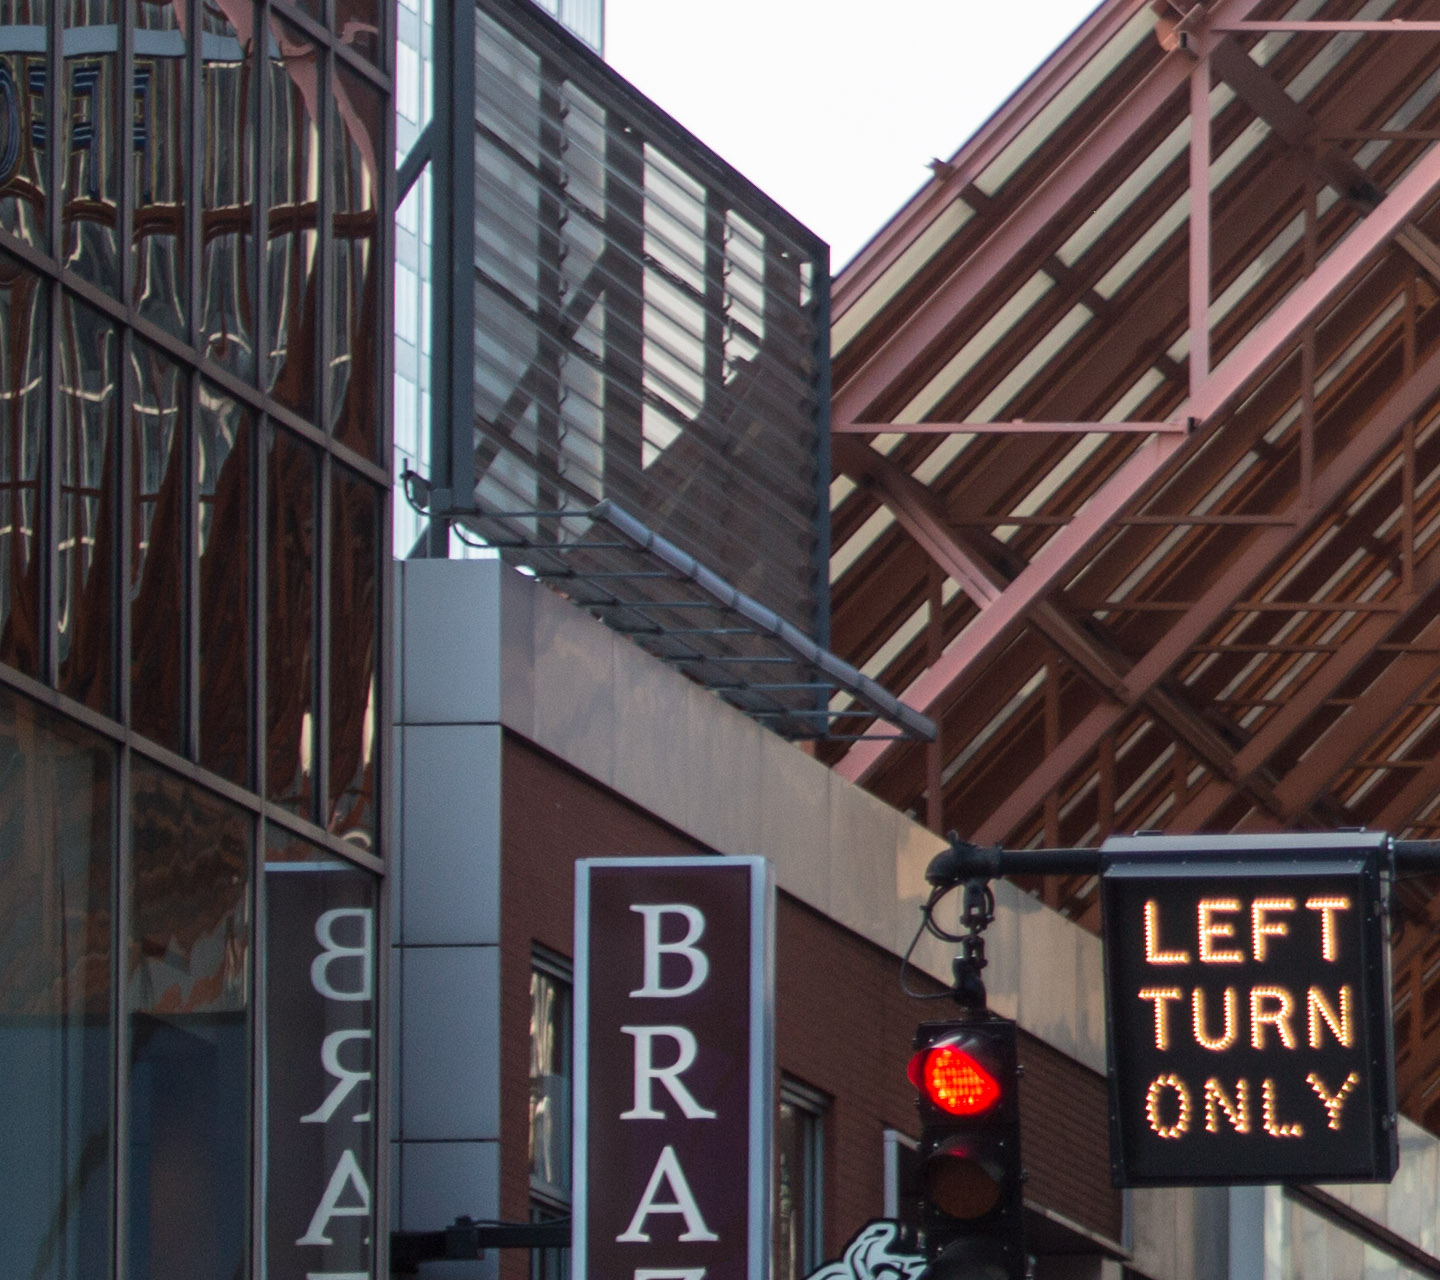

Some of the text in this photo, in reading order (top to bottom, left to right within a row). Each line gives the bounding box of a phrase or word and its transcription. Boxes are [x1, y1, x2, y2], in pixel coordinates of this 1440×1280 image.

[1141, 896, 1352, 964] LEFT
[1138, 984, 1354, 1051] TURN
[1145, 1071, 1361, 1140] ONLY
